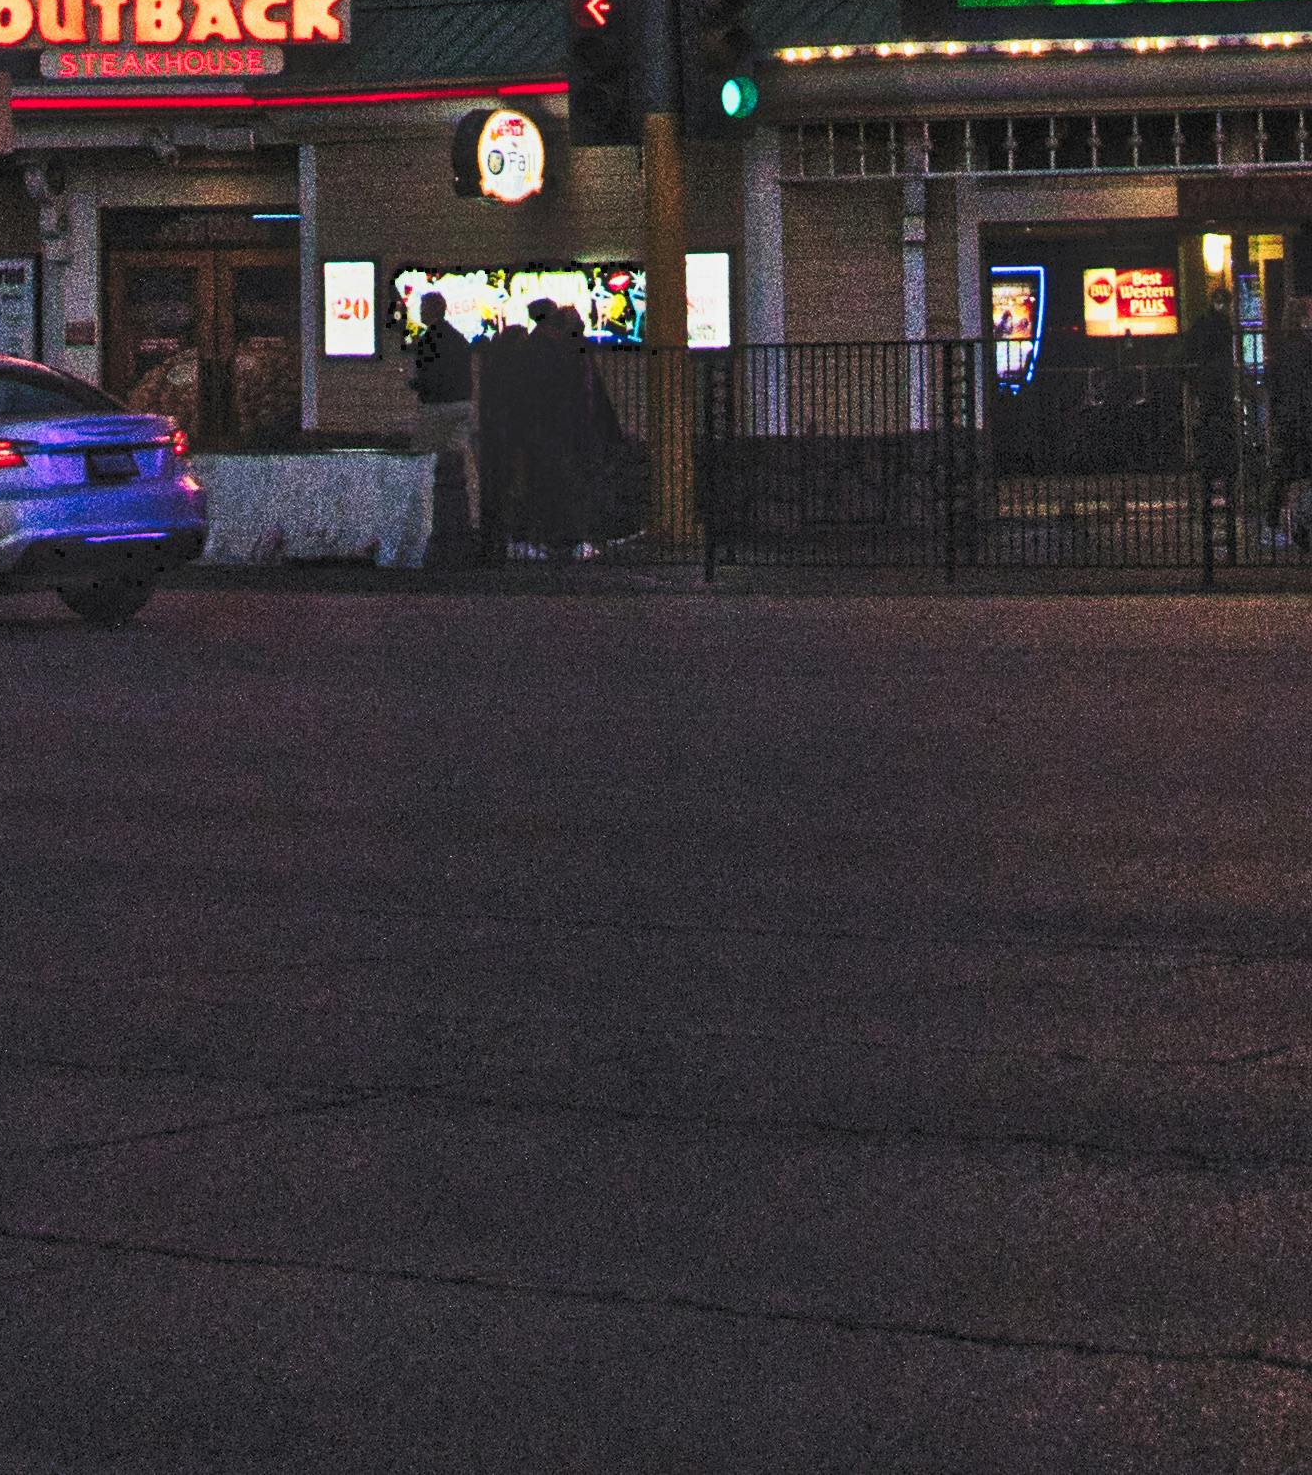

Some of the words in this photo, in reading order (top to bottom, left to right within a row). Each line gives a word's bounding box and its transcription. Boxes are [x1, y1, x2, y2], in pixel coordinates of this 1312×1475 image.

[58, 48, 265, 78] STEAKHOUSE
[1131, 271, 1163, 285] Best
[1120, 286, 1175, 299] Western
[1130, 299, 1168, 313] PLUS
